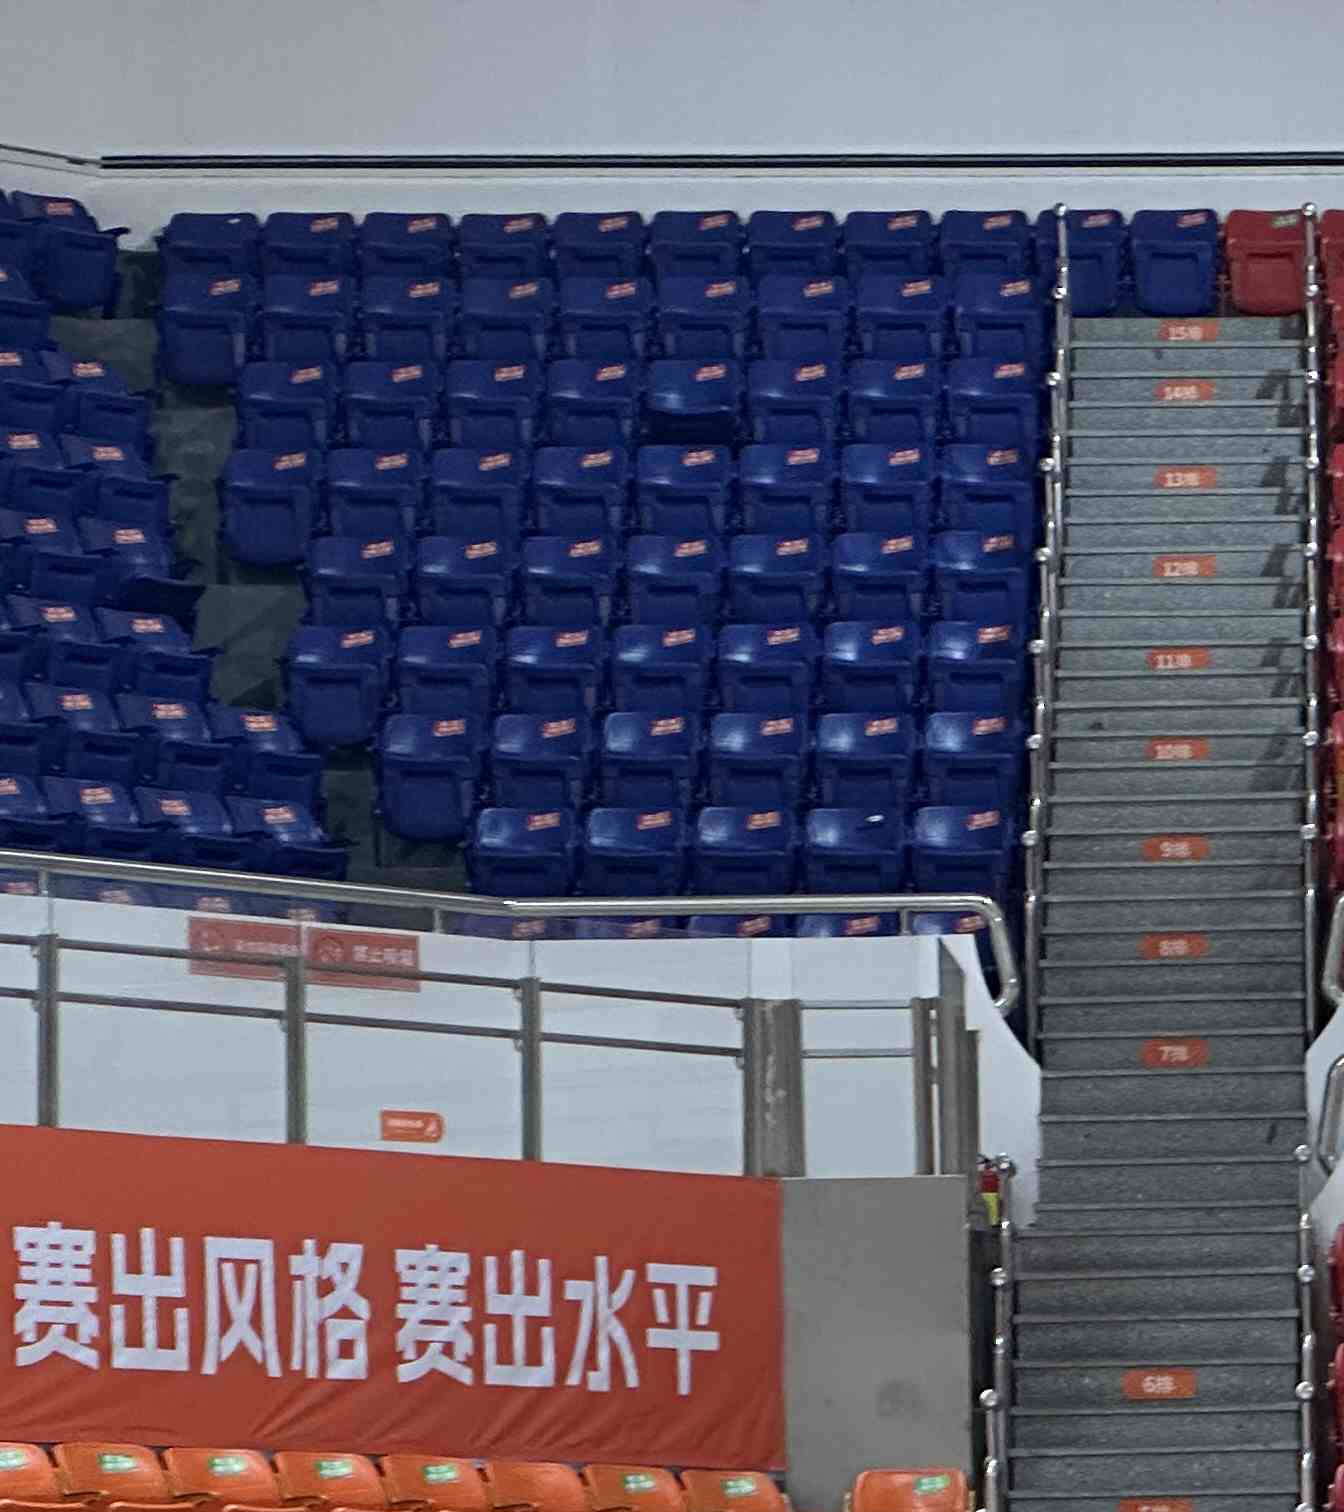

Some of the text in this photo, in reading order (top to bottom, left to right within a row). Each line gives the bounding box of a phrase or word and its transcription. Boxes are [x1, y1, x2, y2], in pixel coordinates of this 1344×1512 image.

[12, 1220, 721, 1396] 赛出风格 赛出水平
